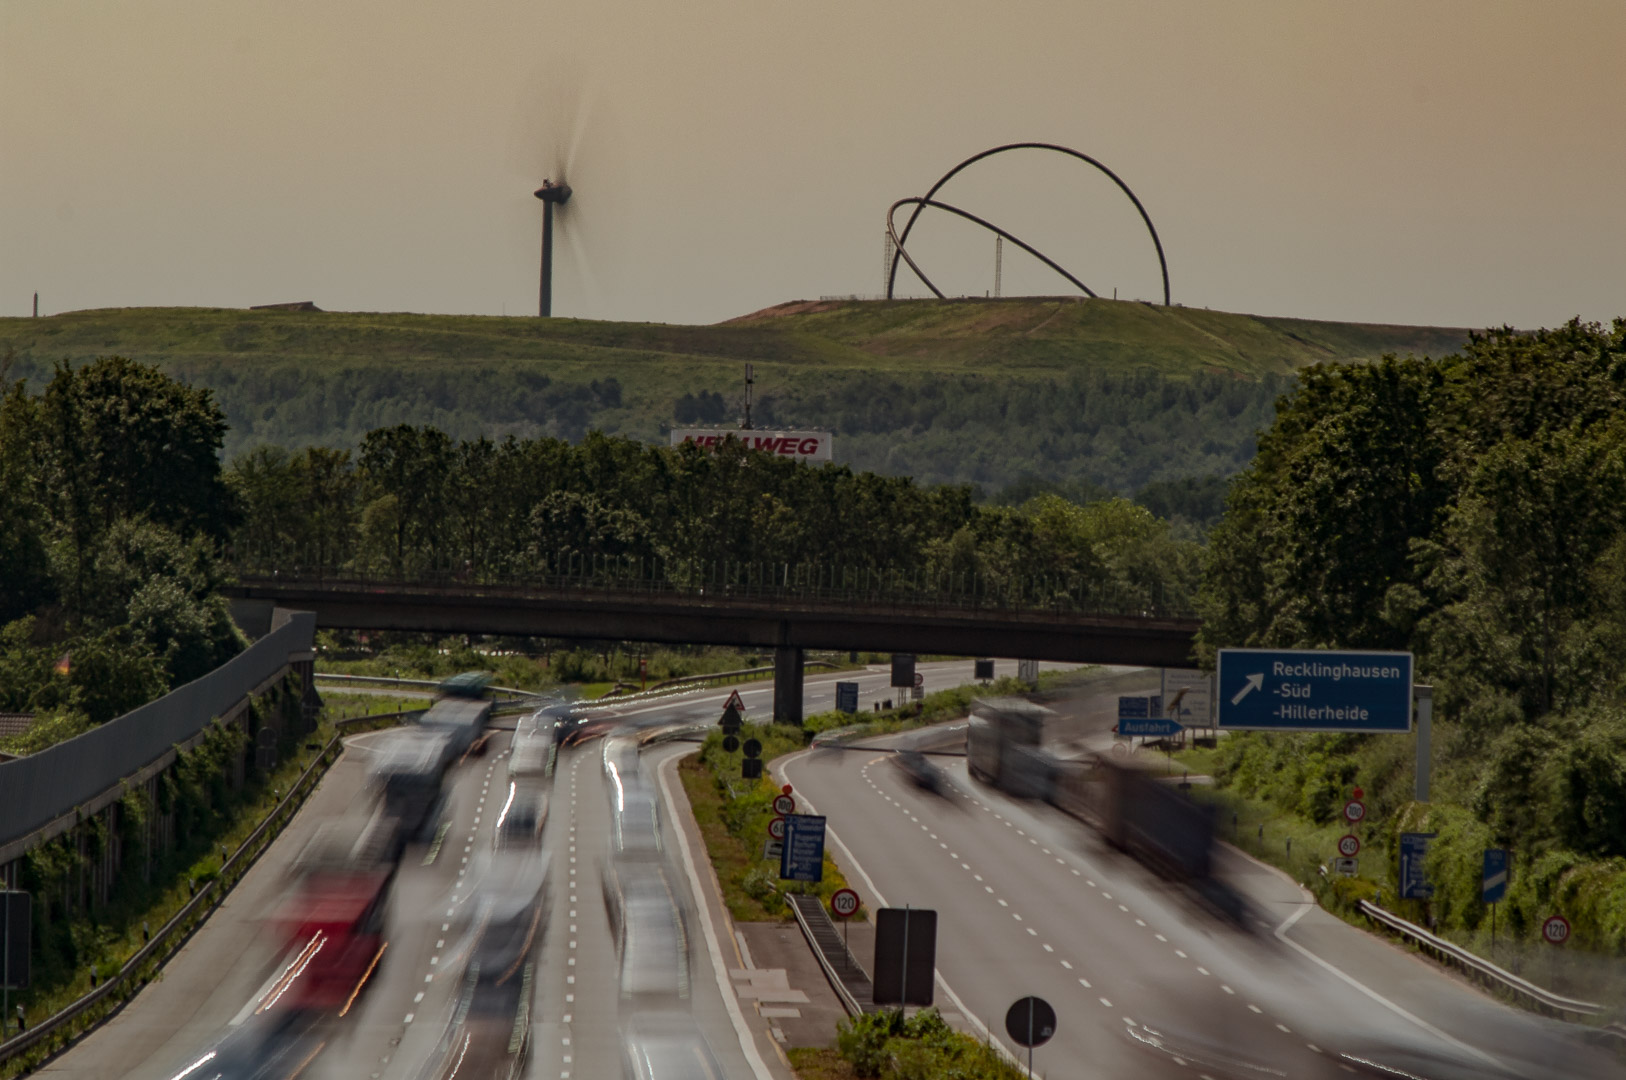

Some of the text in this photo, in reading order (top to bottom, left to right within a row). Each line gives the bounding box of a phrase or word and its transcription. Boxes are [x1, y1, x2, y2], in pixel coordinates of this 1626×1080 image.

[1273, 661, 1400, 681] Recklinghausen
[1273, 683, 1312, 698] -Süd
[1272, 705, 1369, 721] -Hillerheide
[1124, 722, 1171, 733] Ausfahrt
[778, 799, 791, 812] 100
[1348, 806, 1362, 817] 100
[1342, 841, 1356, 851] 60
[837, 897, 855, 909] 120
[1548, 923, 1565, 937] 120
